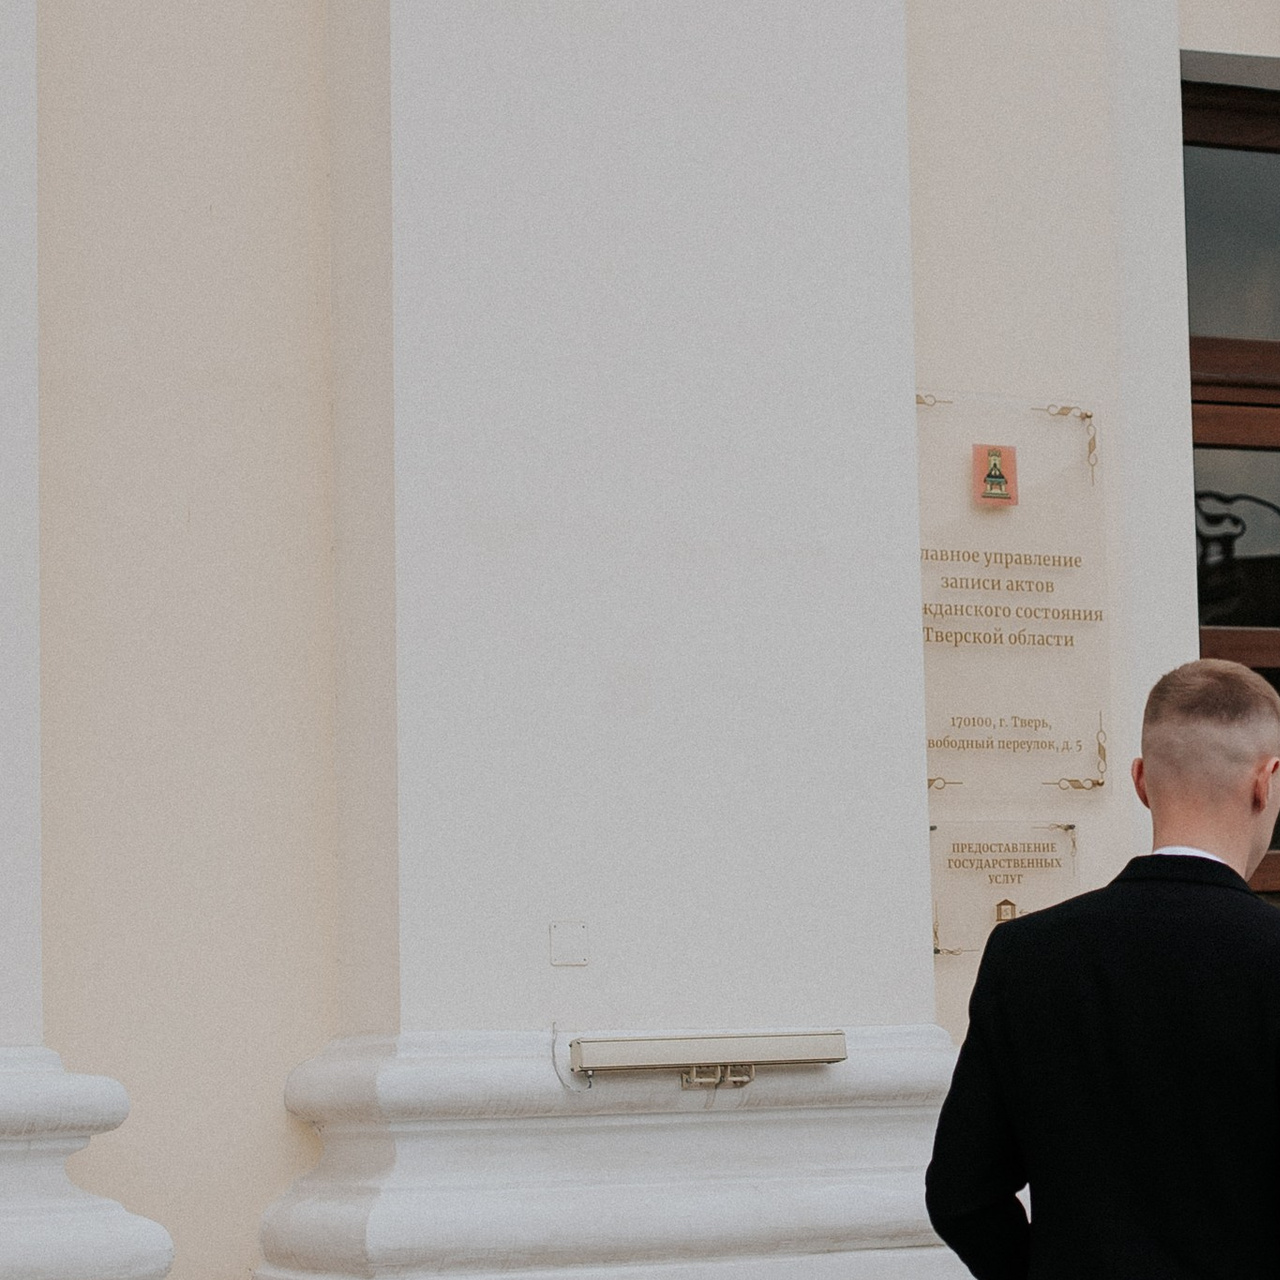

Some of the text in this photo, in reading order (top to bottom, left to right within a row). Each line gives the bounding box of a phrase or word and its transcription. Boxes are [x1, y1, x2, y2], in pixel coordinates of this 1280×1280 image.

[920, 548, 1082, 568] лавное управление
[940, 576, 1055, 593] записи актов
[1015, 606, 1103, 621] состояния
[922, 626, 1075, 647] Тверской области
[951, 715, 1053, 731] 170100, г. Тверь,
[927, 735, 1083, 753] вободный переулок, д. 5
[952, 842, 1058, 854] ПРЕДОСТАВЛЕНИЕ
[947, 858, 1063, 871] ГОСУДАРСТВЕННЫХ
[988, 874, 1024, 885] УСЛУГ
